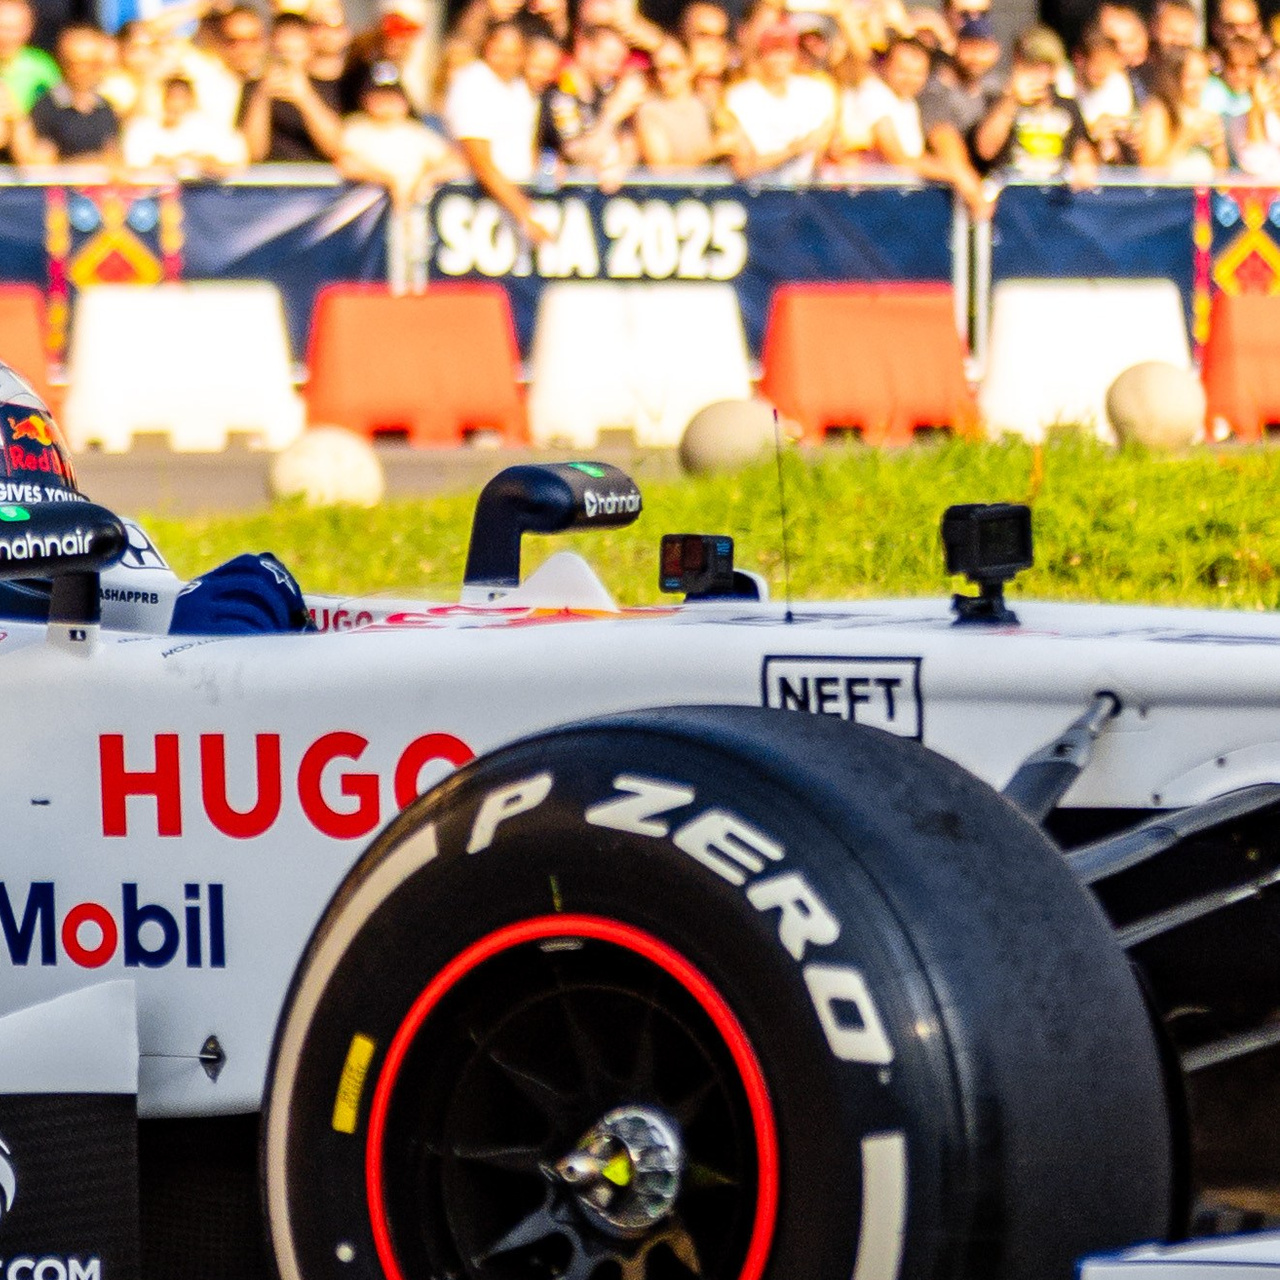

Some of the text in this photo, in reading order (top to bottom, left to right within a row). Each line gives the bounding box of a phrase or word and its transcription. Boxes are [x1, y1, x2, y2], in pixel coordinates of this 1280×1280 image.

[602, 197, 749, 281] 2025
[777, 675, 903, 722] NEFT
[466, 770, 896, 1066] P ZERO
